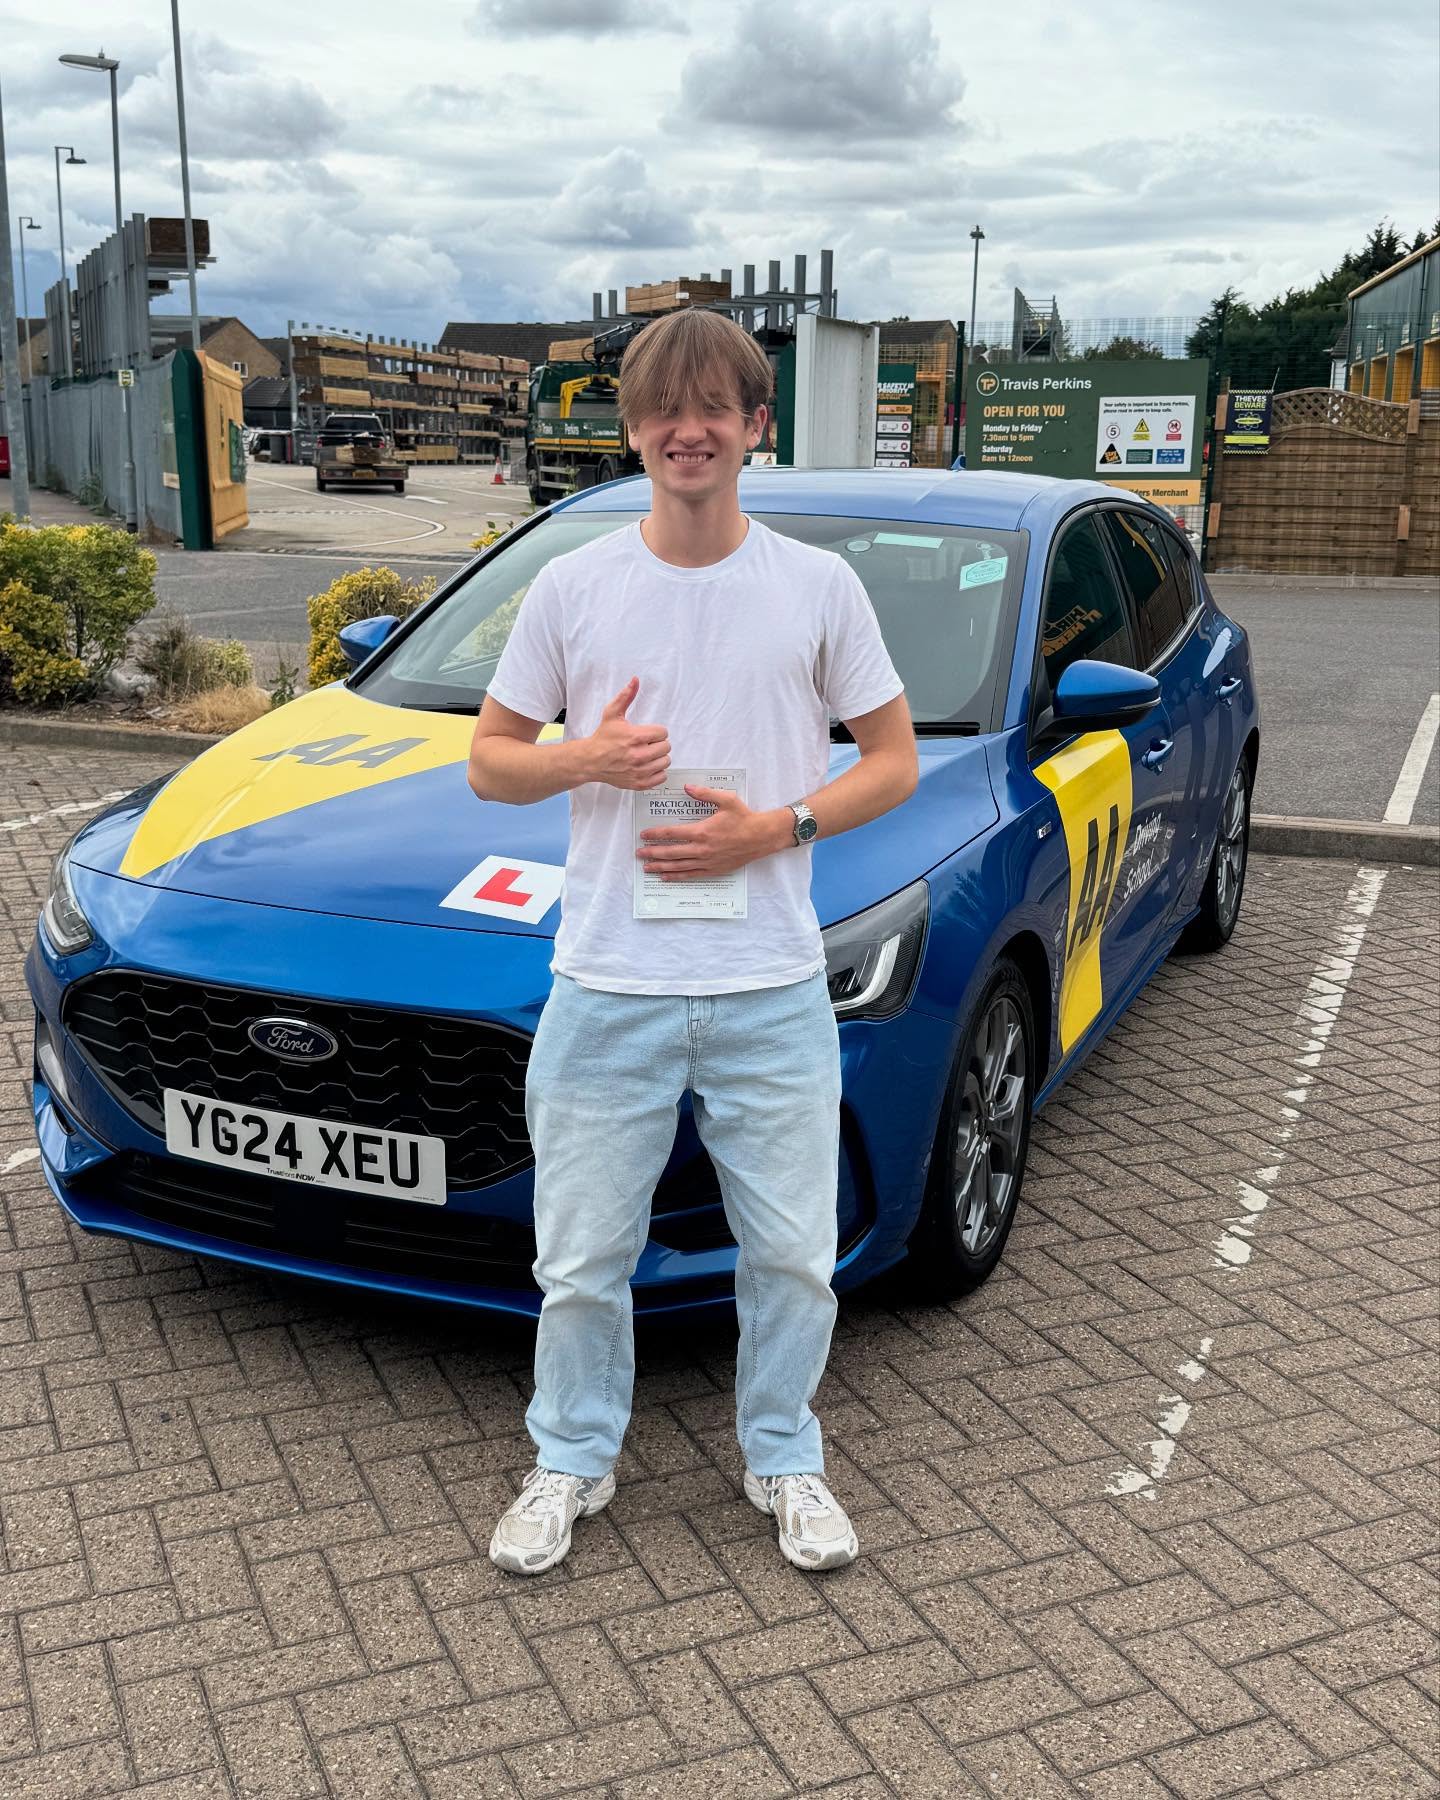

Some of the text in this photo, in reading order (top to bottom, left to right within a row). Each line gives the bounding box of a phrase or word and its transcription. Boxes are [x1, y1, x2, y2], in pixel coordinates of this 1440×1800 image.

[1001, 376, 1093, 391] Travis Perkins
[983, 404, 1065, 418] OPEN FOR YOU
[982, 423, 1043, 434] Monday to Friday
[1110, 427, 1117, 436] 5
[982, 434, 1035, 443] 7.30am to 5pm
[982, 445, 1014, 454] Saturday
[981, 454, 1034, 463] 8am to 12noon
[1129, 488, 1189, 497] ders Merchant
[250, 734, 431, 769] AA
[649, 800, 719, 808] PRACTICAL DRIV
[650, 808, 718, 816] TEST PASS CERTIFIC
[1131, 810, 1163, 857] Driving
[1123, 847, 1156, 900] School
[473, 867, 534, 908] L
[1066, 803, 1120, 962] AA
[267, 1026, 315, 1053] Ford
[180, 1098, 420, 1189] YG24 XEU
